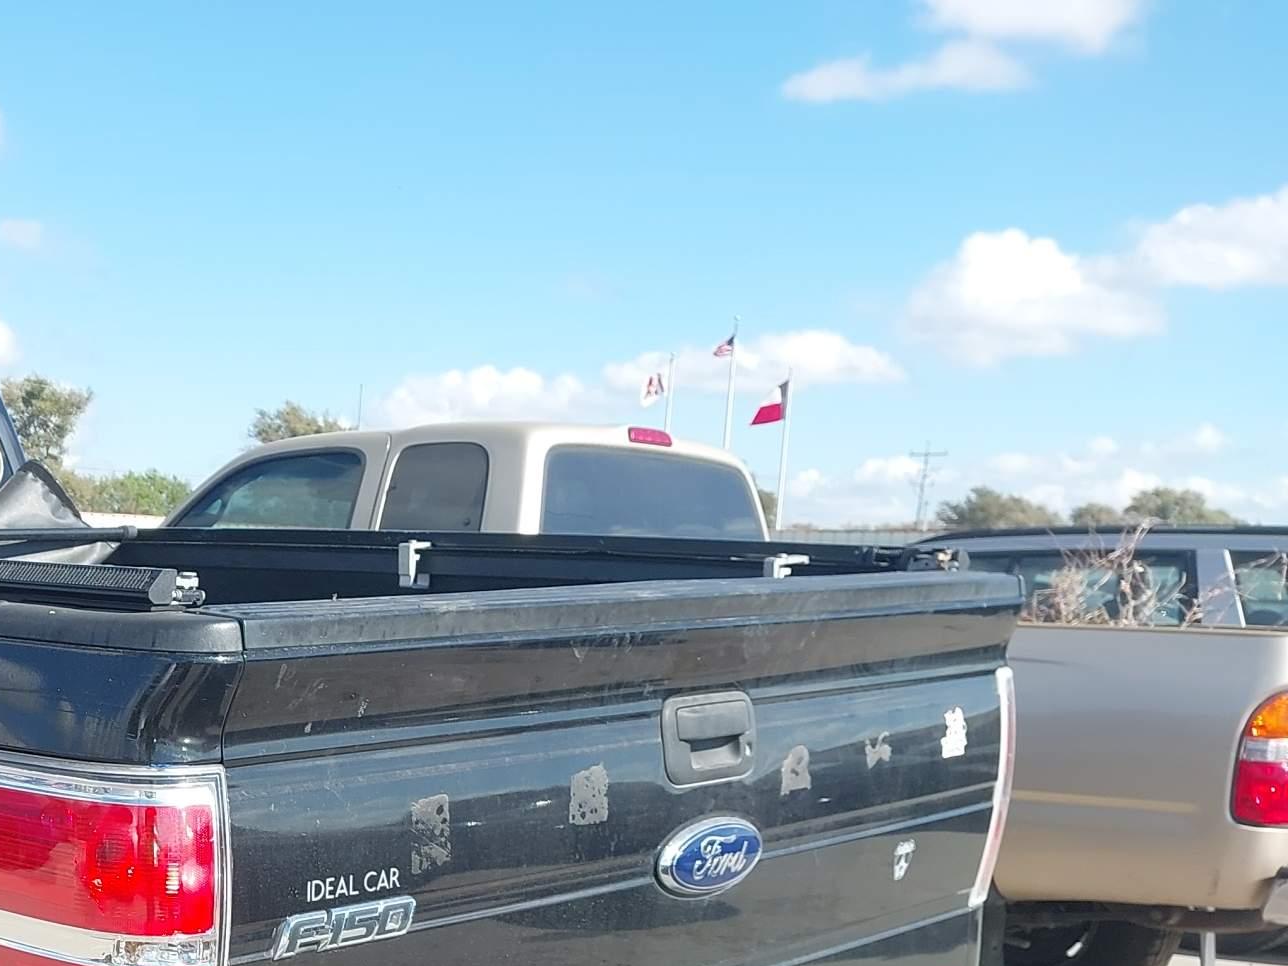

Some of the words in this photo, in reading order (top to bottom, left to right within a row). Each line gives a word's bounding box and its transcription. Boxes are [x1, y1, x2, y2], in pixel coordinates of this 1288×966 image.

[693, 834, 748, 881] Ford
[306, 874, 360, 903] IDEAL
[363, 867, 401, 893] CAR
